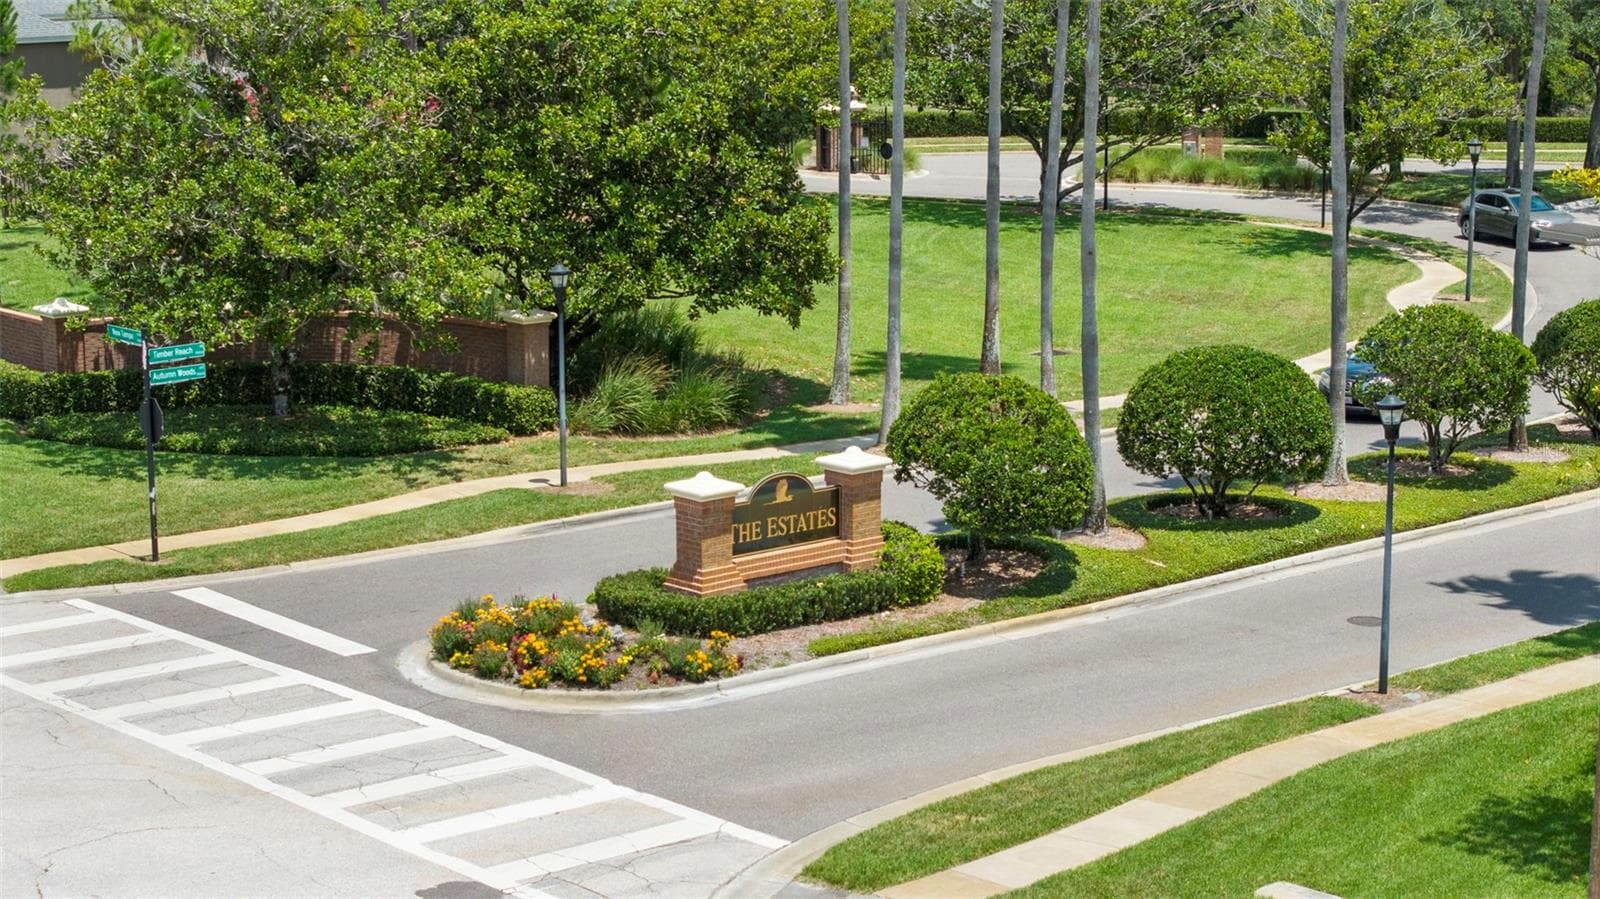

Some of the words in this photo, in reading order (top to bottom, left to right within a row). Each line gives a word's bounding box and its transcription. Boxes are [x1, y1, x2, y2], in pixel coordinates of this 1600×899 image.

[153, 350, 173, 359] Timber
[175, 347, 193, 356] Reach
[153, 371, 176, 380] Autumn
[177, 368, 196, 377] Woods
[731, 521, 762, 545] THE
[767, 507, 836, 538] ESTATES
